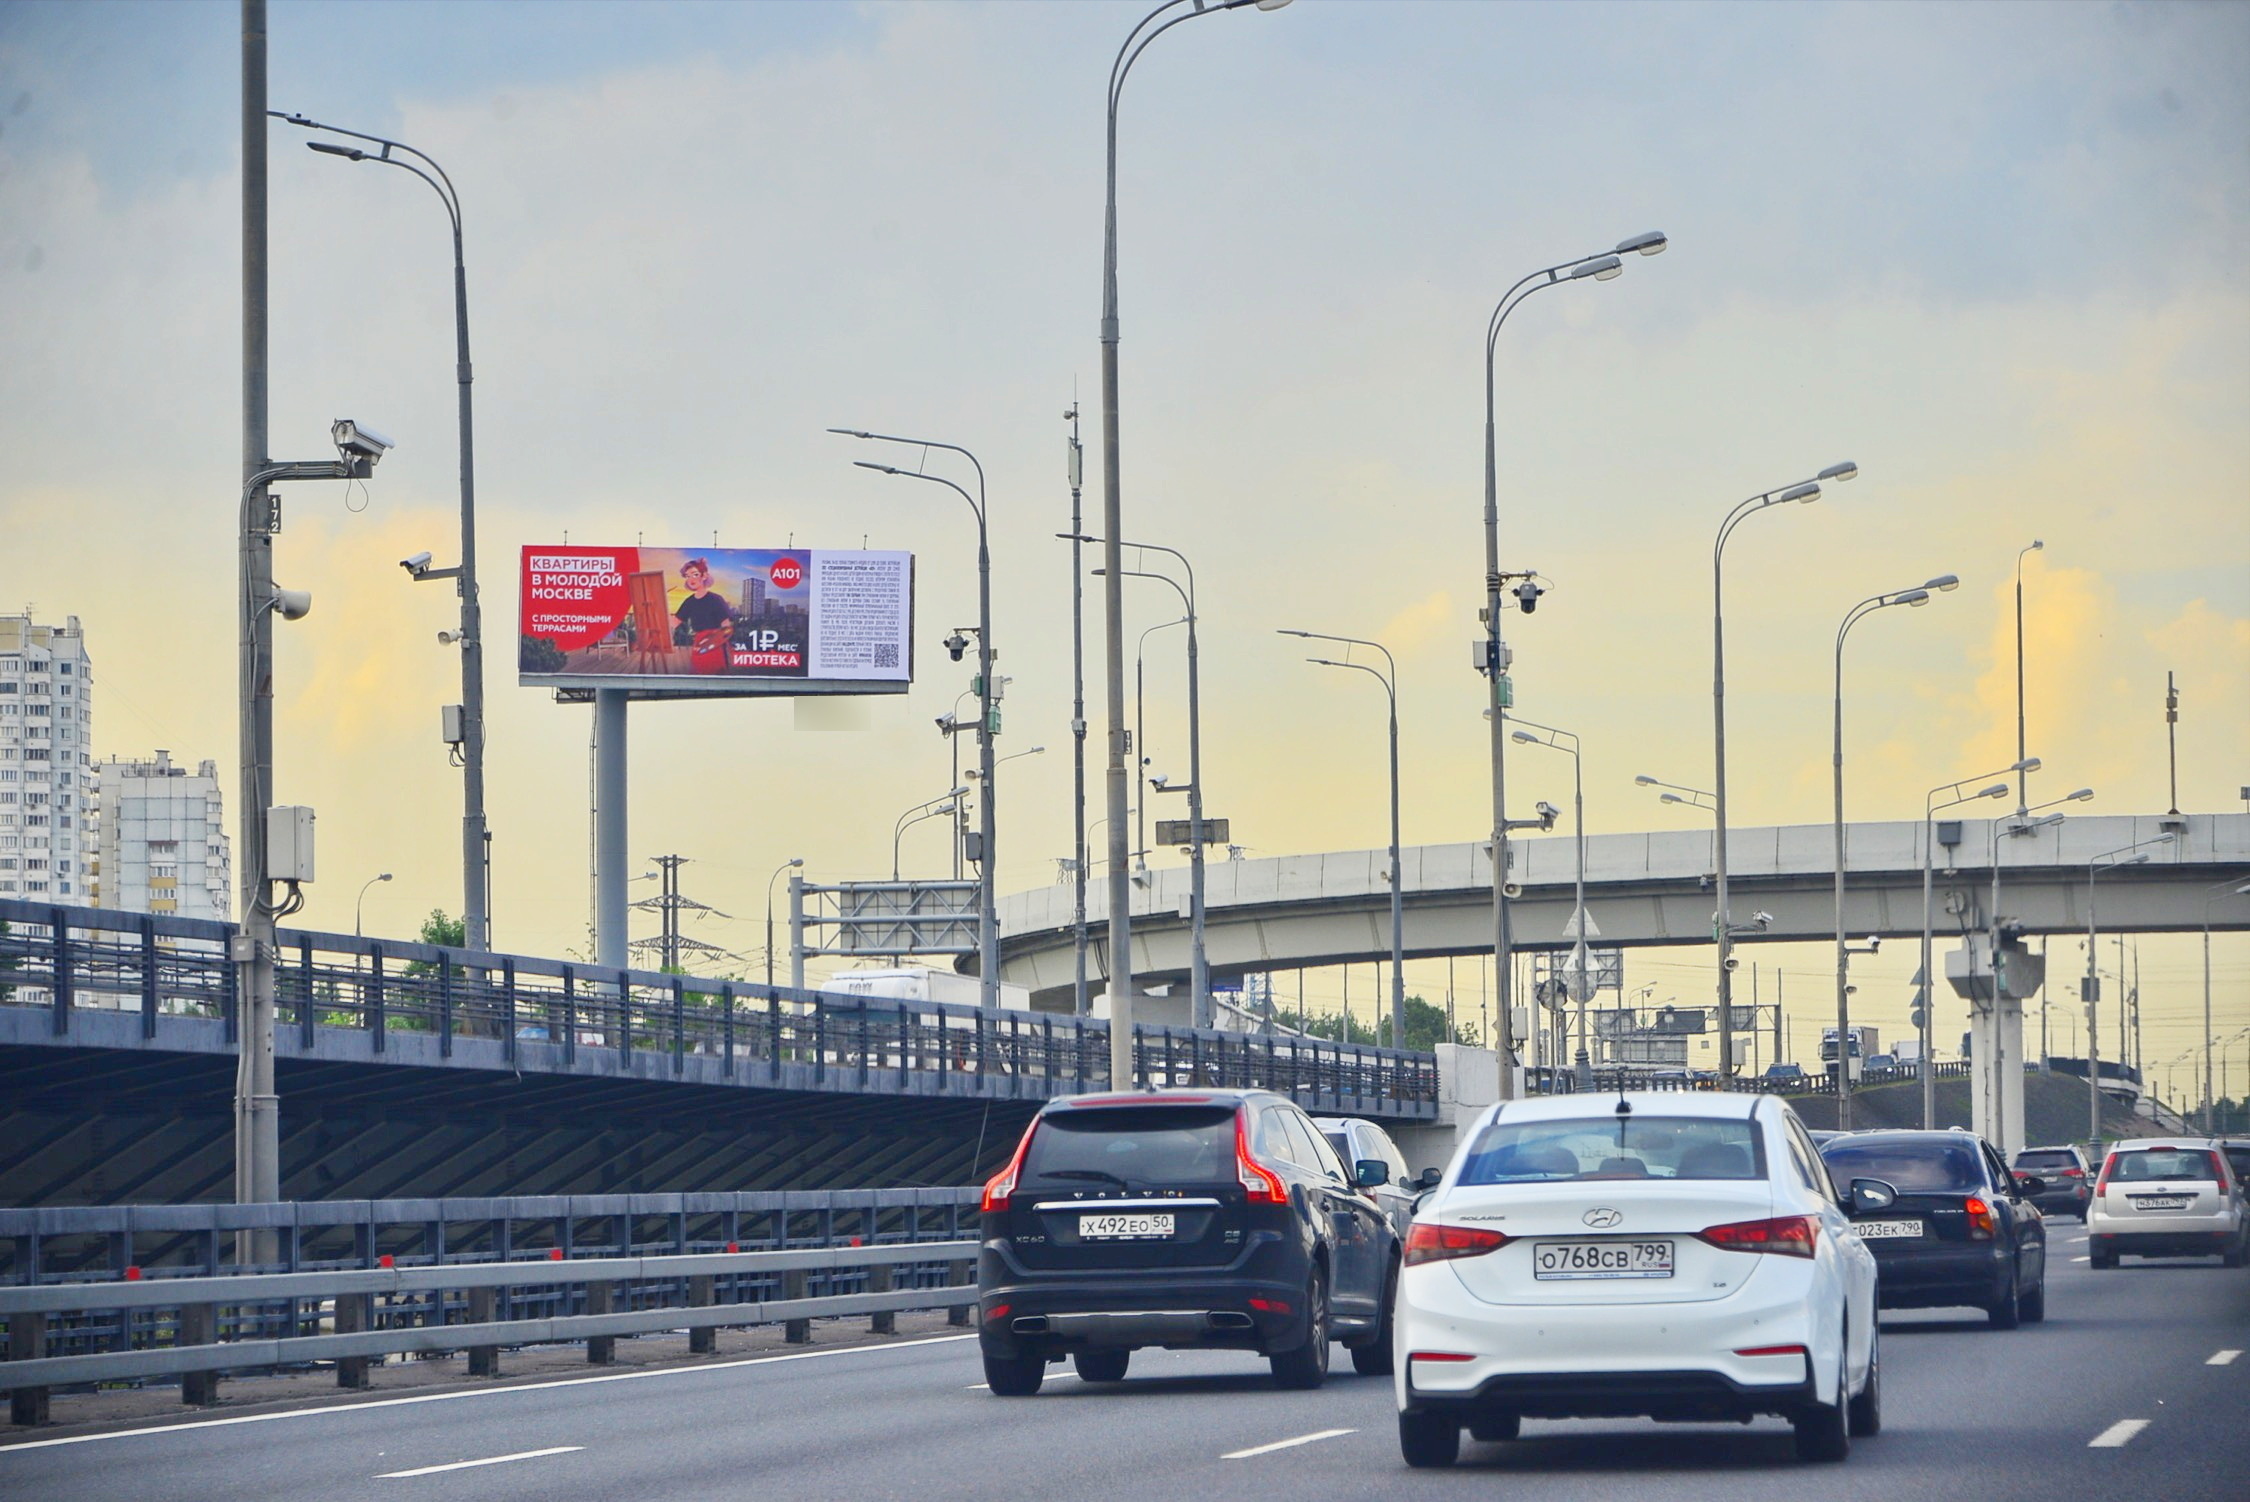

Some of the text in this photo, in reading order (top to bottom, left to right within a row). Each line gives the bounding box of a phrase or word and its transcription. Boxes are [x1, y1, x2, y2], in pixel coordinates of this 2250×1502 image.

[271, 497, 279, 532] 172
[532, 558, 612, 570] КВАРТИРЫ
[532, 573, 622, 588] В МОЛОДОЙ
[532, 588, 593, 600] МОСКВЕ
[532, 614, 611, 623] С ПРОСТОРНЫМИ
[532, 624, 586, 633] ТЕРРАСАМИ
[734, 643, 747, 651] ЗА
[733, 654, 798, 666] ИПОТЕКА
[1153, 1215, 1169, 1228] 50
[1853, 1222, 1918, 1237] 023ЕК 790
[1633, 1244, 1667, 1261] 799
